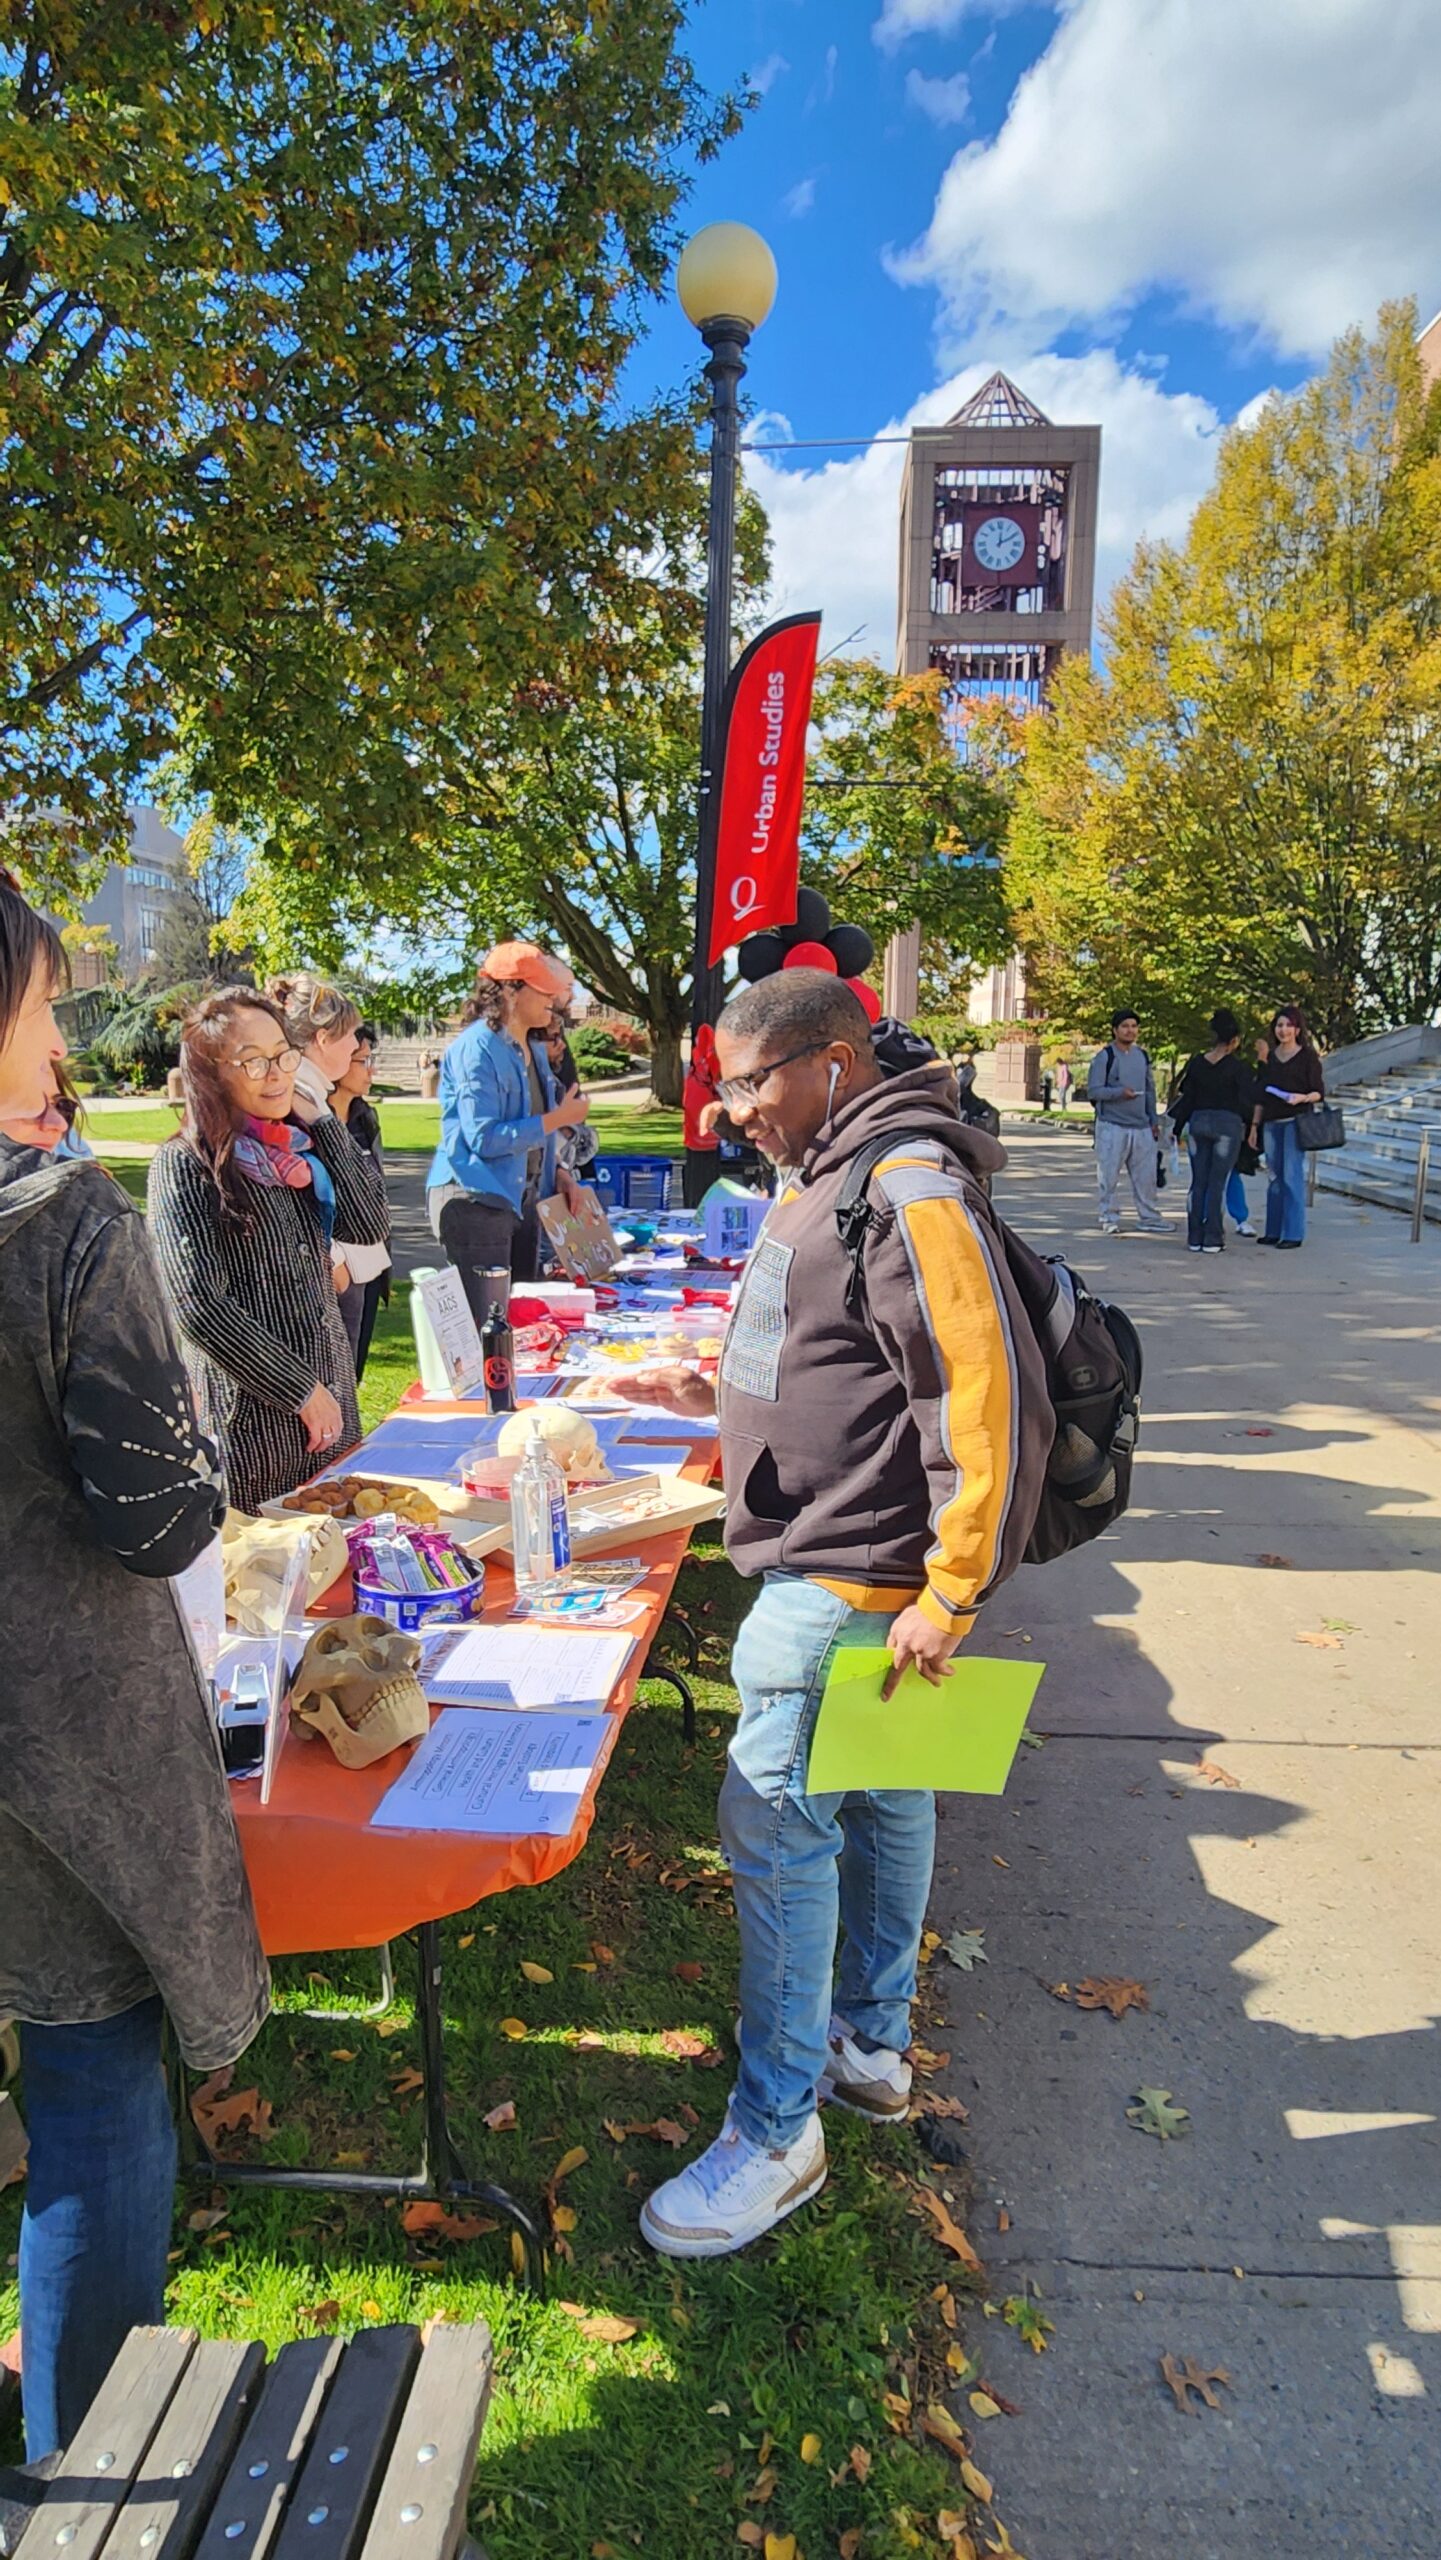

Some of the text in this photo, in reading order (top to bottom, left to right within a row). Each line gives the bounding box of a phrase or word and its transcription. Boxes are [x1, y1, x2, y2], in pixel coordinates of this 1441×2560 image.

[751, 671, 785, 854] Urban Studies
[445, 1731, 478, 1769] Anthropology
[457, 1737, 495, 1787] Health and Culture
[505, 1765, 526, 1785] Human
[516, 1742, 539, 1764] Ecology
[469, 1782, 494, 1809] Cultural
[485, 1758, 508, 1781] Heritage
[497, 1747, 512, 1757] and
